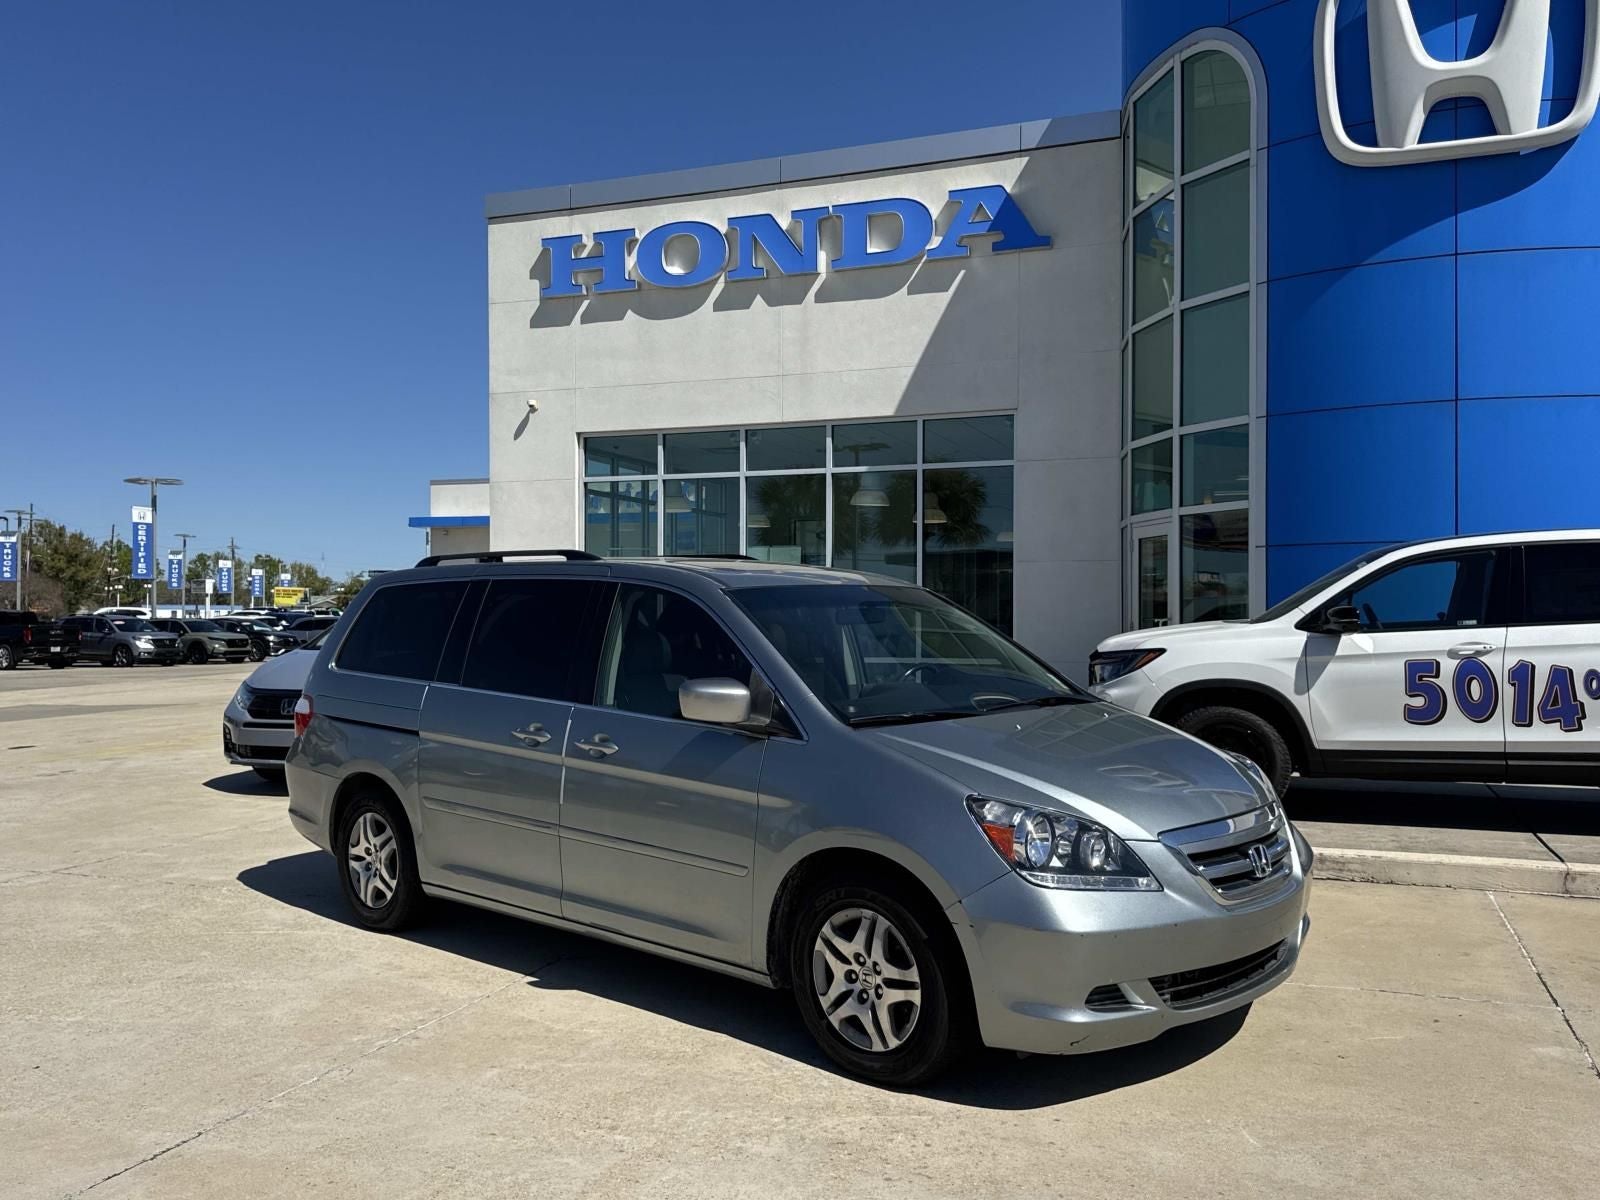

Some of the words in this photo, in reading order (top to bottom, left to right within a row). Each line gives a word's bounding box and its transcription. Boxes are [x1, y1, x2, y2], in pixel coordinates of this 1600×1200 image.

[541, 184, 1052, 298] HONDA
[3, 542, 12, 578] TRUCKS
[137, 524, 147, 574] CERTIFIED
